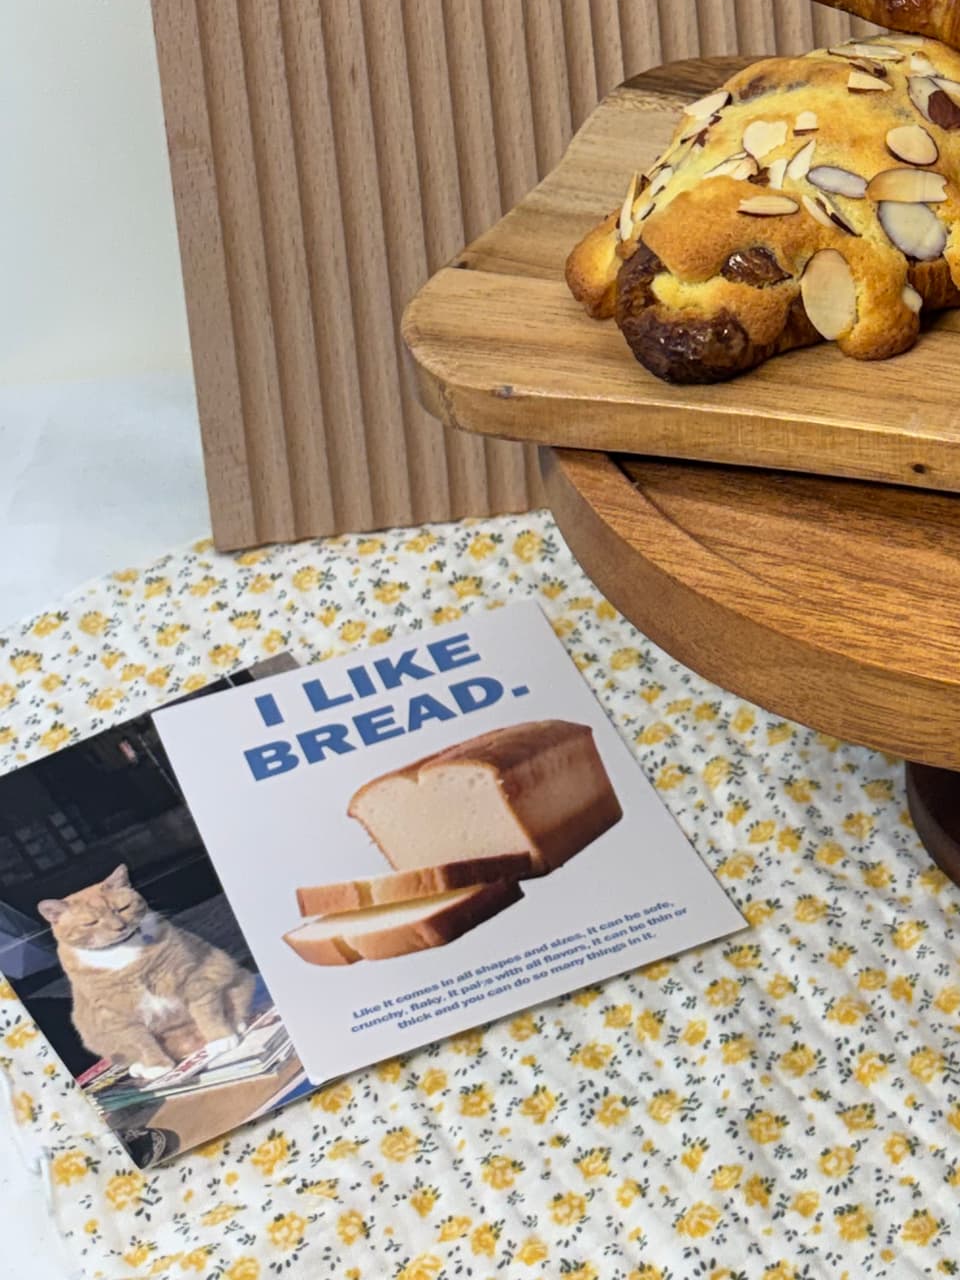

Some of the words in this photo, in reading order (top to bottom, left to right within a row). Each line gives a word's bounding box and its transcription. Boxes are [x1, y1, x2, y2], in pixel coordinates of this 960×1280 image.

[254, 693, 285, 727] I
[302, 632, 481, 713] LIKE
[243, 676, 530, 782] BREAD.
[352, 1005, 382, 1019] Like
[382, 998, 394, 1008] it
[395, 984, 440, 1004] comes
[456, 970, 473, 983] all
[475, 954, 522, 976] shapes
[524, 943, 548, 959] and
[550, 932, 587, 949] sizes,
[586, 926, 598, 936] it
[599, 918, 624, 931] can
[623, 911, 641, 922] be
[398, 1013, 433, 1030] thick
[434, 1002, 461, 1017] and
[461, 993, 486, 1008] you
[487, 983, 513, 997] can
[514, 977, 531, 988] do
[532, 970, 549, 981] so
[549, 957, 586, 975] many
[586, 941, 628, 961] things
[627, 937, 642, 947] in
[495, 966, 523, 981] with
[525, 958, 542, 971] all
[604, 928, 628, 941] can
[628, 922, 646, 933] be
[647, 913, 673, 927] thin
[674, 907, 688, 918] or
